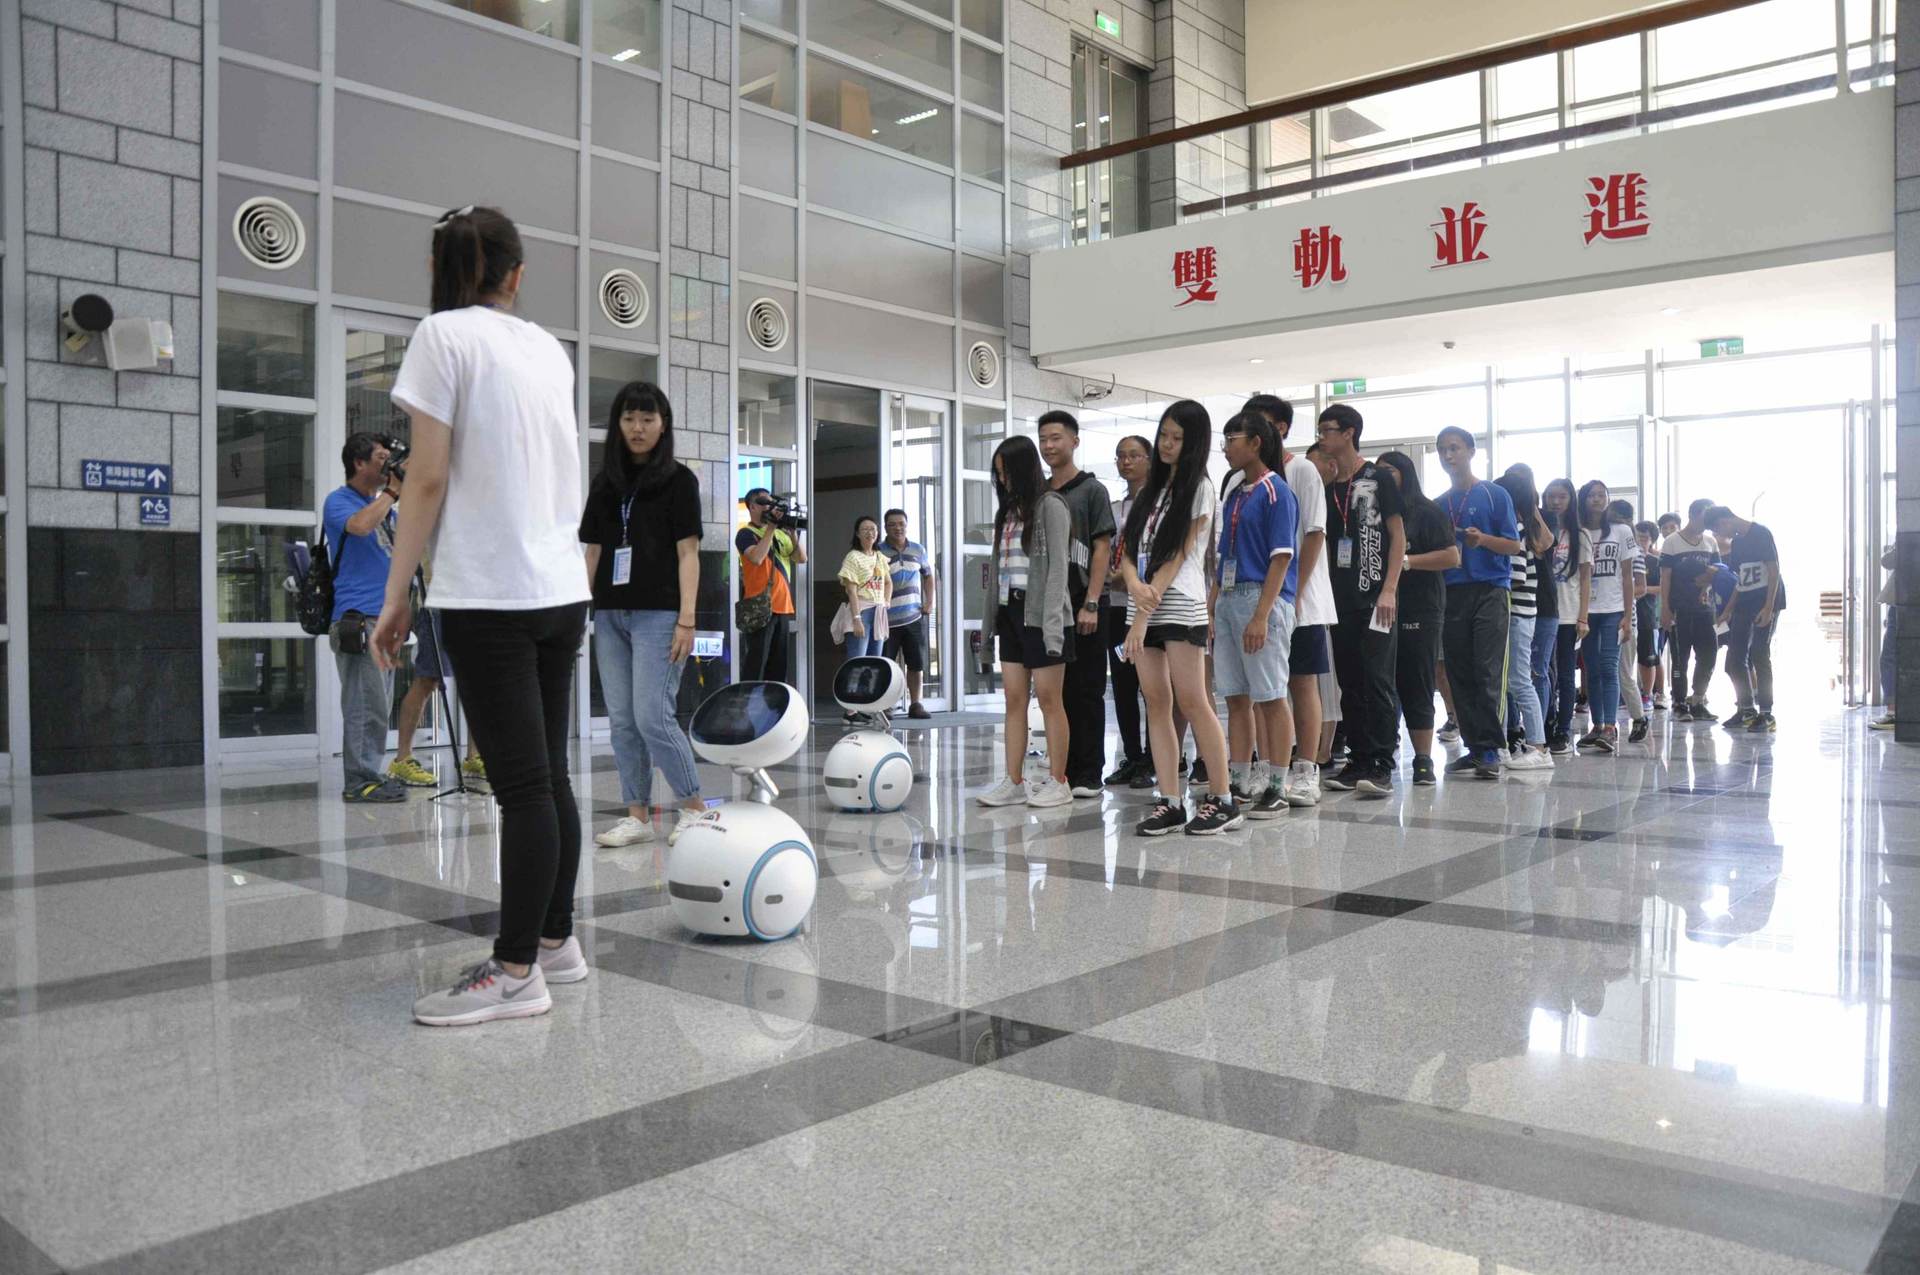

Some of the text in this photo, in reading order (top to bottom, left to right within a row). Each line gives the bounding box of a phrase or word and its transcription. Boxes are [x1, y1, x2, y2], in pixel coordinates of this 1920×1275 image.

[1172, 172, 1651, 309] 雙軌並進
[1368, 527, 1382, 582] STYLE
